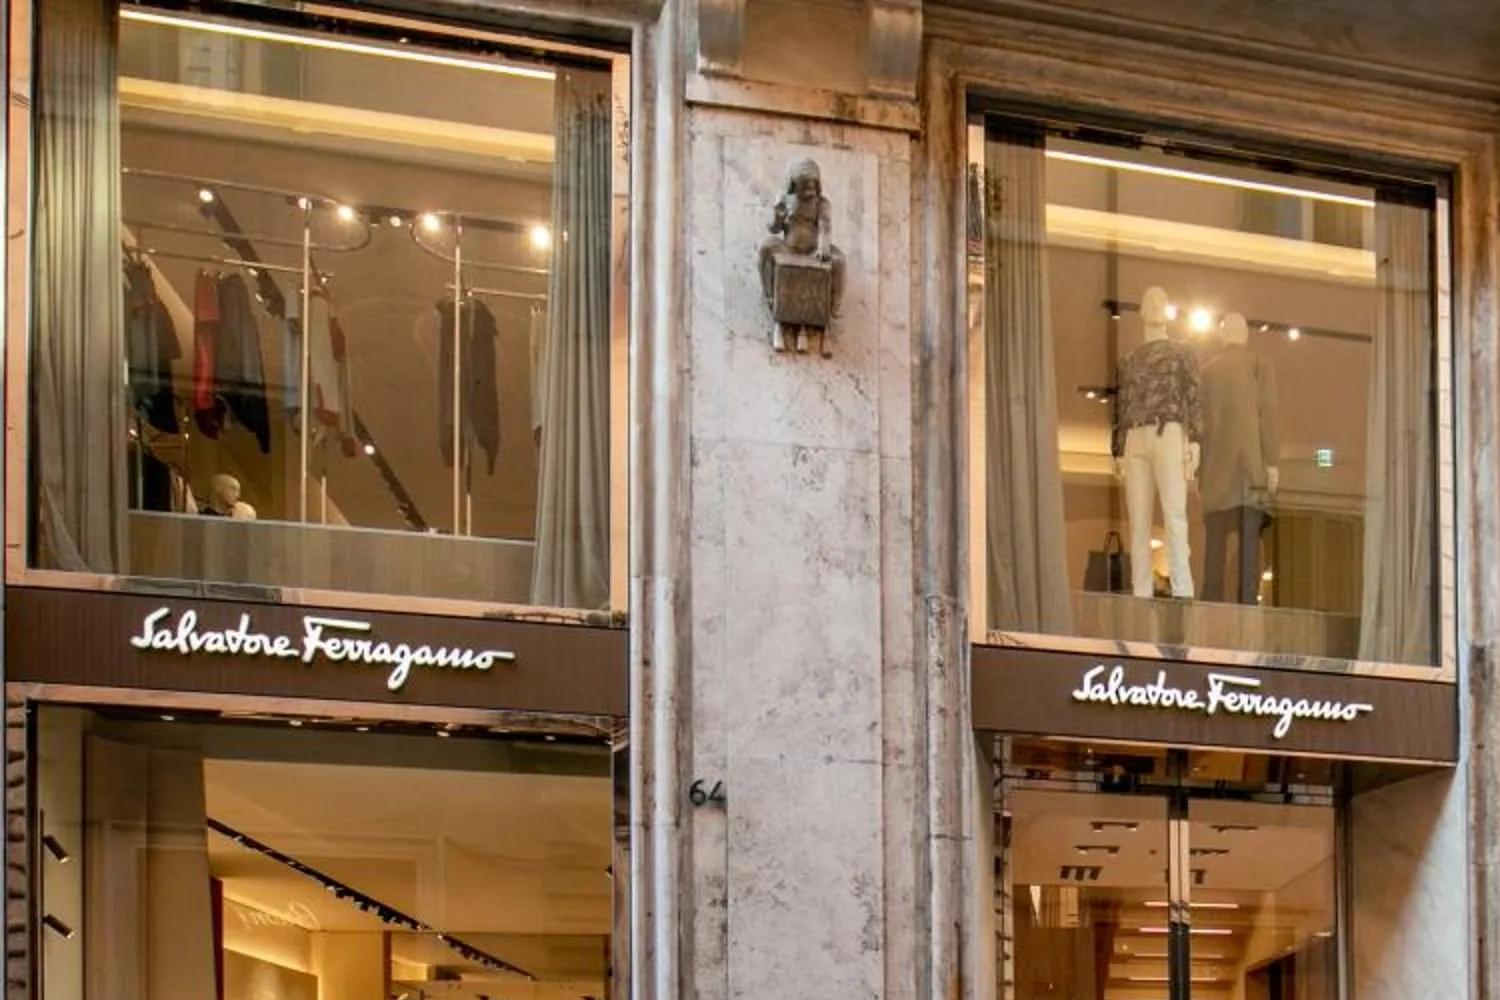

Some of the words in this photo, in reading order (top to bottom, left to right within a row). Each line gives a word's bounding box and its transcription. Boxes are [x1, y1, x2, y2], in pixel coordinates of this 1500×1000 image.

[130, 606, 301, 657] Salvatore
[302, 615, 517, 692] Ferragamo
[1072, 665, 1206, 708] Salvatore
[1208, 672, 1374, 739] Ferragamo
[689, 778, 727, 808] 64
